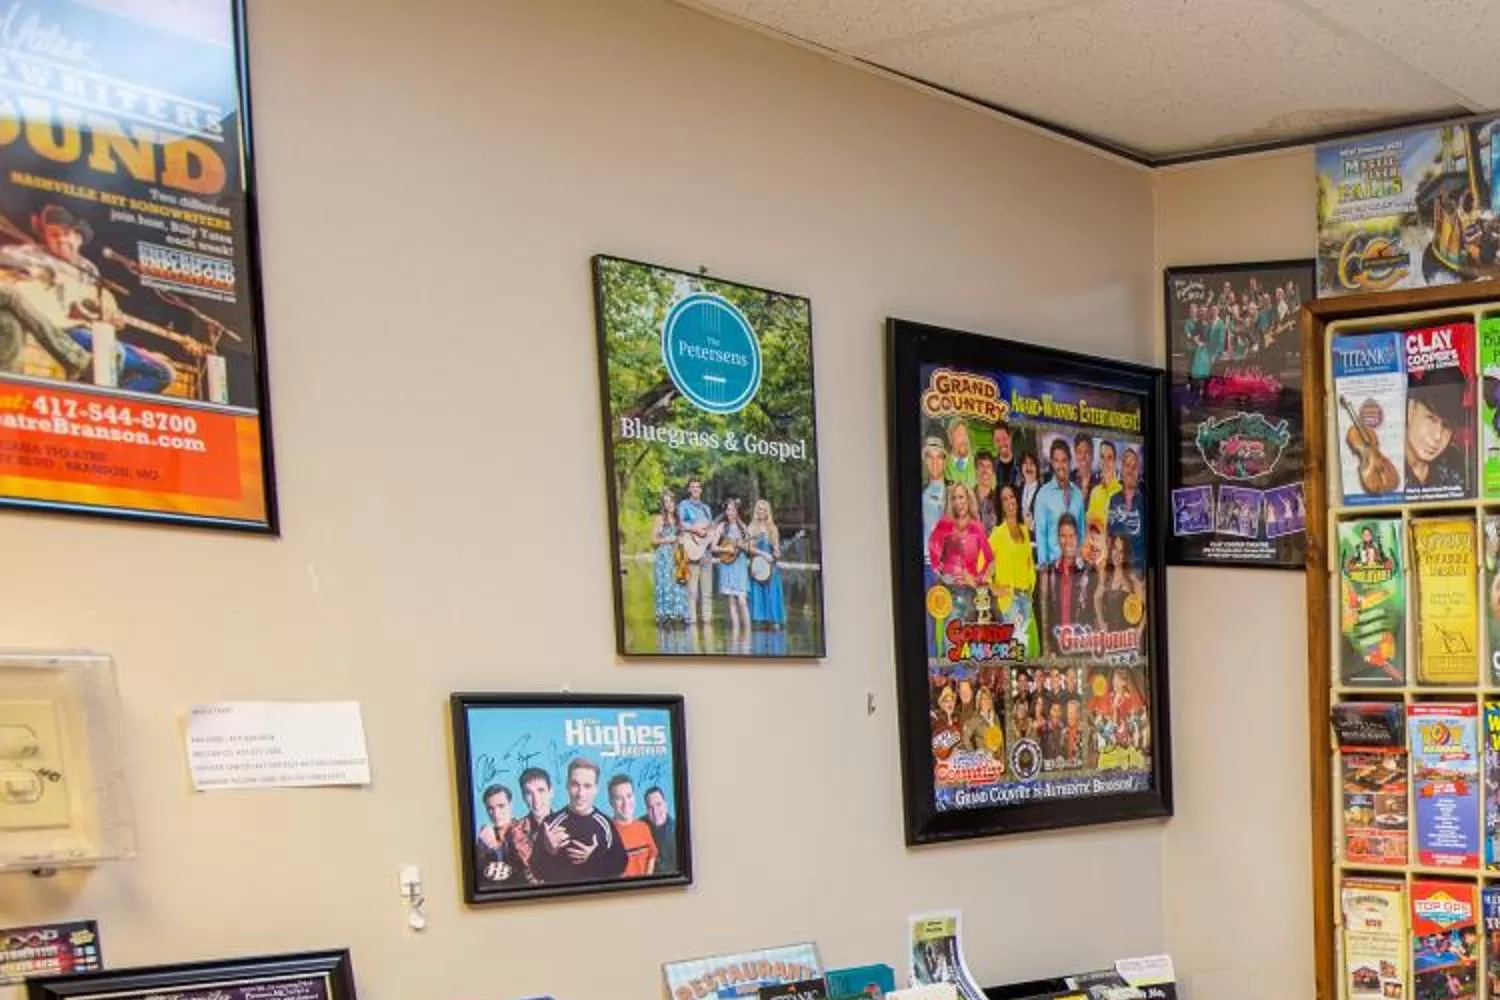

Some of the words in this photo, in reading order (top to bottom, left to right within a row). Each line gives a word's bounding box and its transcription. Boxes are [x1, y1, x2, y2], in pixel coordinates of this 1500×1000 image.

[678, 339, 749, 367] Petersens
[1406, 329, 1452, 354] CLAY
[935, 374, 996, 399] GRAND
[32, 394, 197, 435] 417-544-8700
[926, 394, 1008, 422] COUNTRY
[620, 415, 720, 449] Bluegrass
[724, 431, 740, 452] &
[743, 433, 807, 463] Gospel
[564, 711, 667, 758] Hughes
